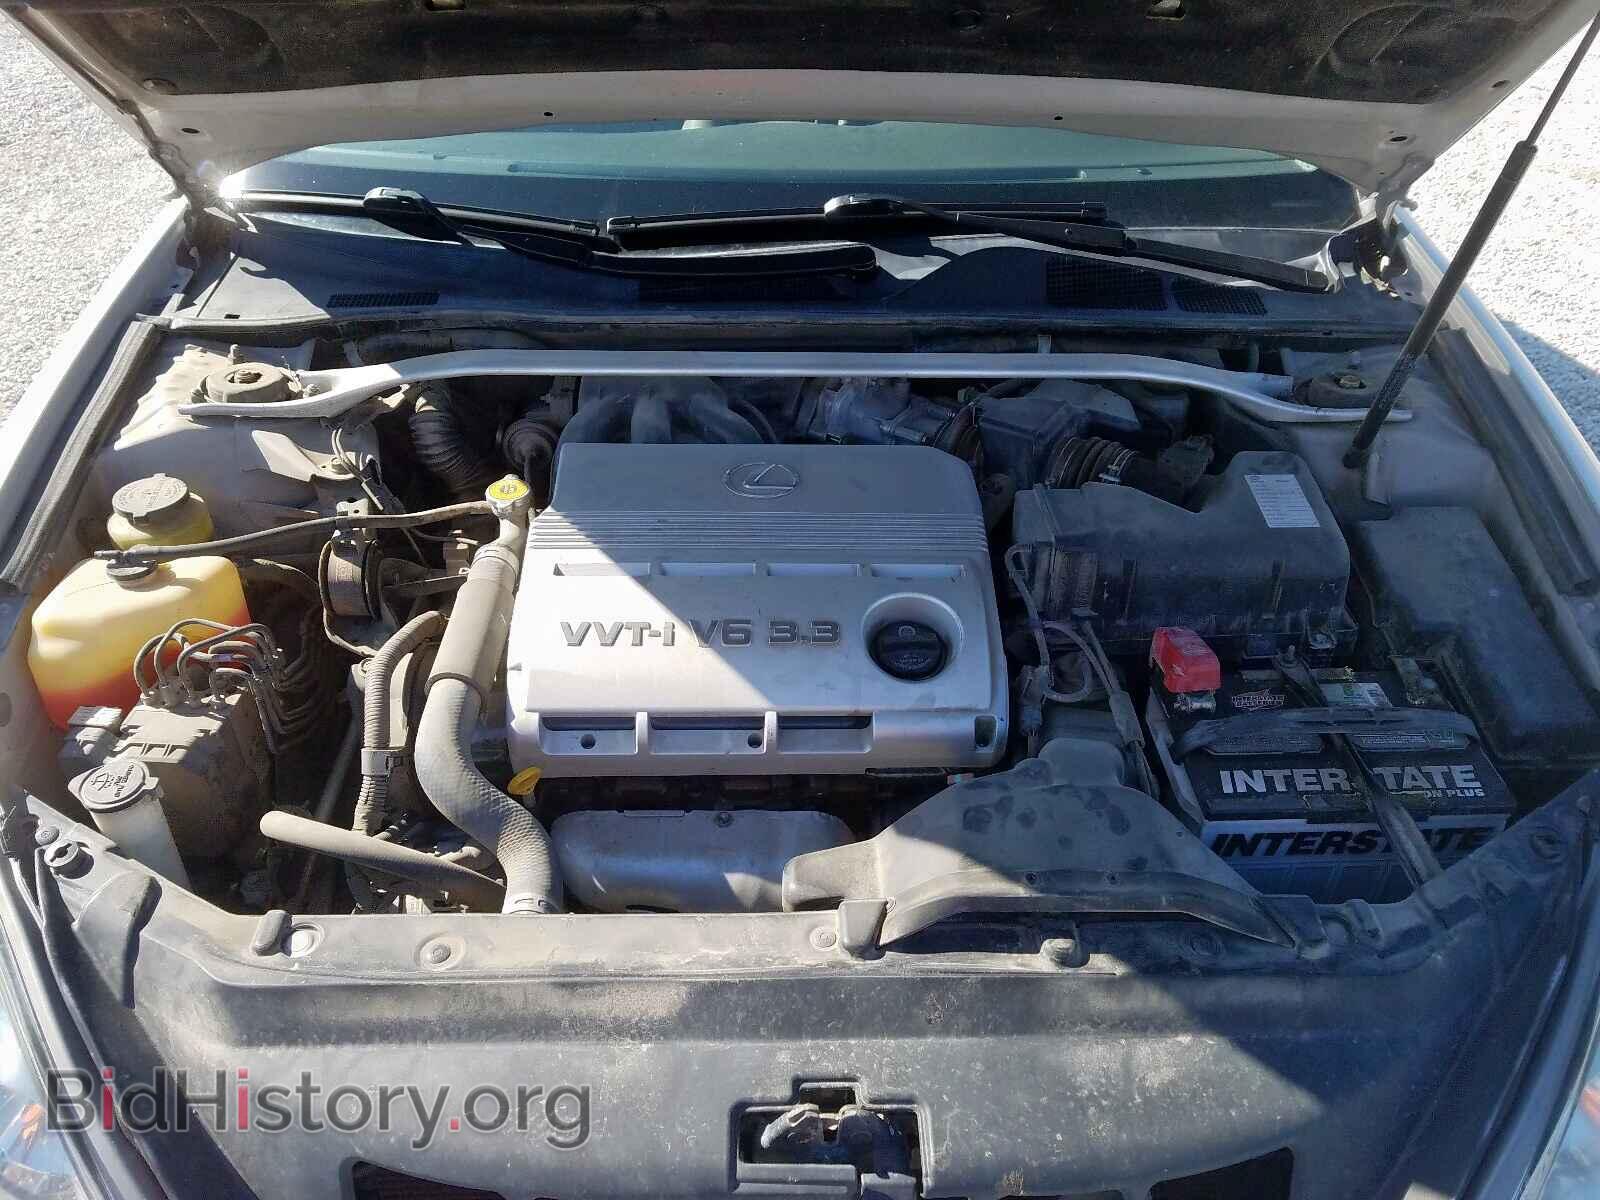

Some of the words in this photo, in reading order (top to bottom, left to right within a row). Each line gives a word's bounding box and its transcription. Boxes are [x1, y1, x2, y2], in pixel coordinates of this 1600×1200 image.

[687, 619, 752, 648] V6
[768, 619, 841, 648] 3.3
[1219, 764, 1481, 794] INTERTATE
[1447, 788, 1485, 798] PLUS
[1212, 827, 1492, 857] INTERSTE
